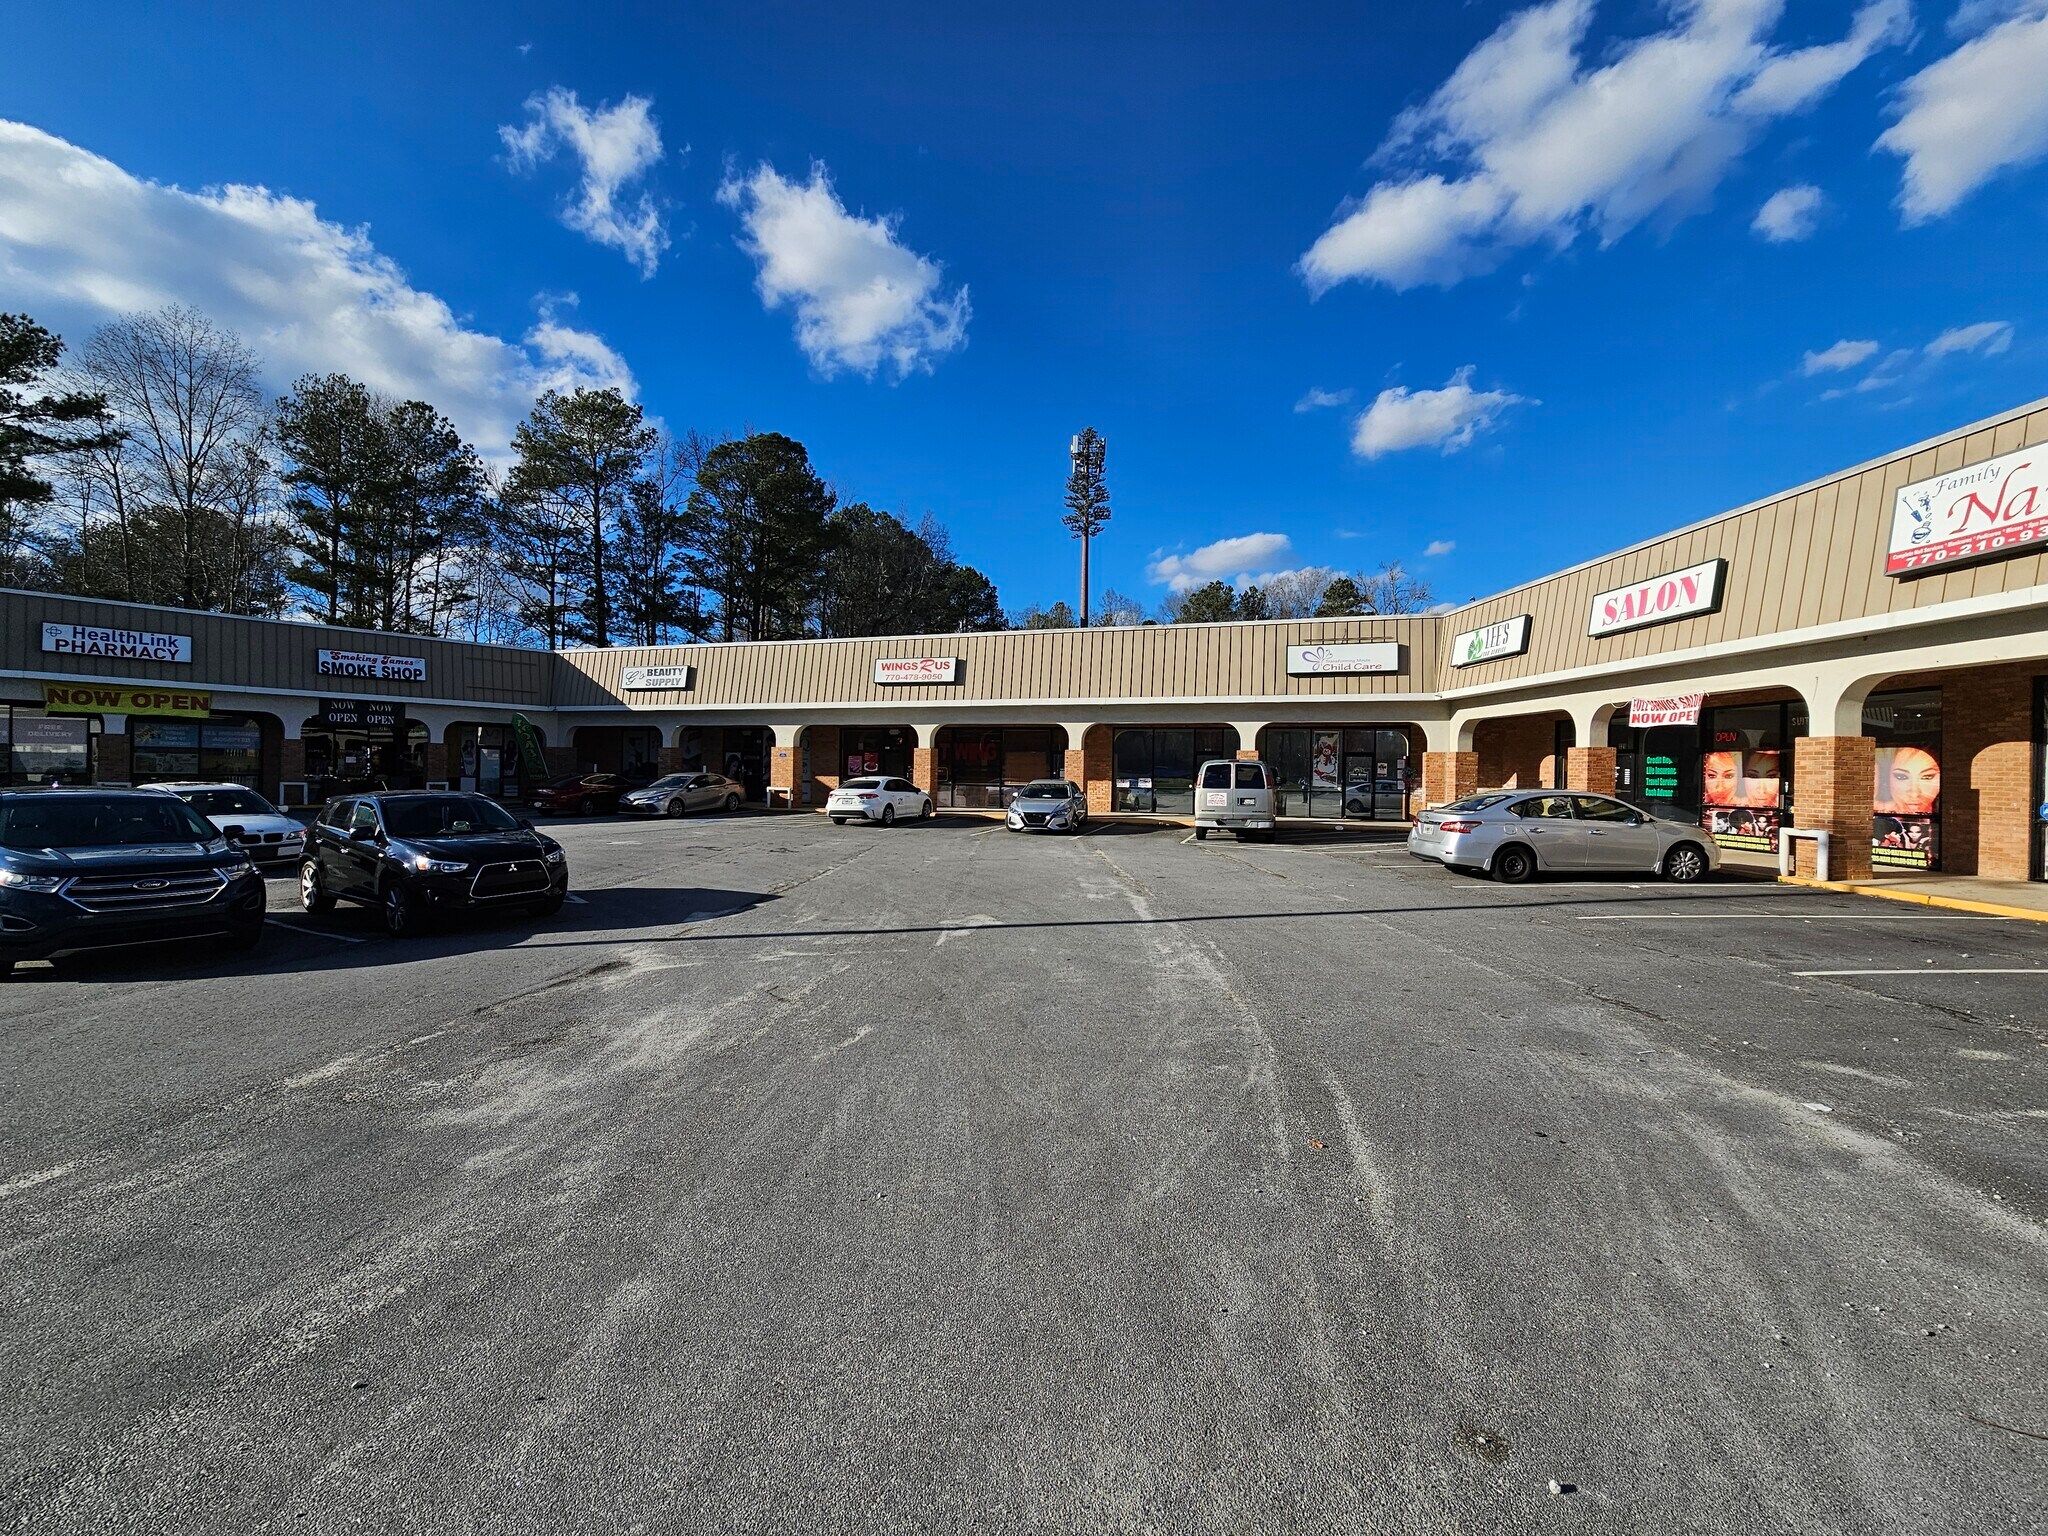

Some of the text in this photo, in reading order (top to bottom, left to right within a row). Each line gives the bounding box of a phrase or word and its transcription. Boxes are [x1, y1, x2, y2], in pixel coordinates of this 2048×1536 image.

[1932, 463, 2001, 498] Family
[1947, 462, 2048, 535] Na
[1892, 550, 1914, 560] Complete
[1914, 546, 1924, 556] Nail
[1924, 544, 1944, 554] Services
[1948, 538, 1972, 548] Manicures
[1976, 531, 2001, 542] Pedicures
[2006, 525, 2023, 534] Waxes
[2028, 521, 2039, 530] Spa
[1602, 572, 1702, 626] SALON
[72, 626, 178, 648] HealthLink
[1485, 623, 1510, 649] LEE'S
[55, 638, 180, 660] PHARMACY
[330, 650, 414, 666] Smoking James
[881, 659, 950, 673] WINGS R US
[320, 660, 422, 680] SMOKE SHOP
[626, 670, 645, 685] G's
[646, 668, 684, 676] BEAUTY
[646, 678, 681, 686] SUPPLY
[48, 688, 209, 710] NOW OPEN
[331, 700, 356, 710] NOW
[1679, 693, 1704, 709] SALON
[369, 703, 392, 712] NOW
[329, 713, 358, 723] OPEN
[367, 715, 394, 724] OPEN
[1632, 713, 1666, 723] NOW
[1716, 732, 1737, 742] OPEN
